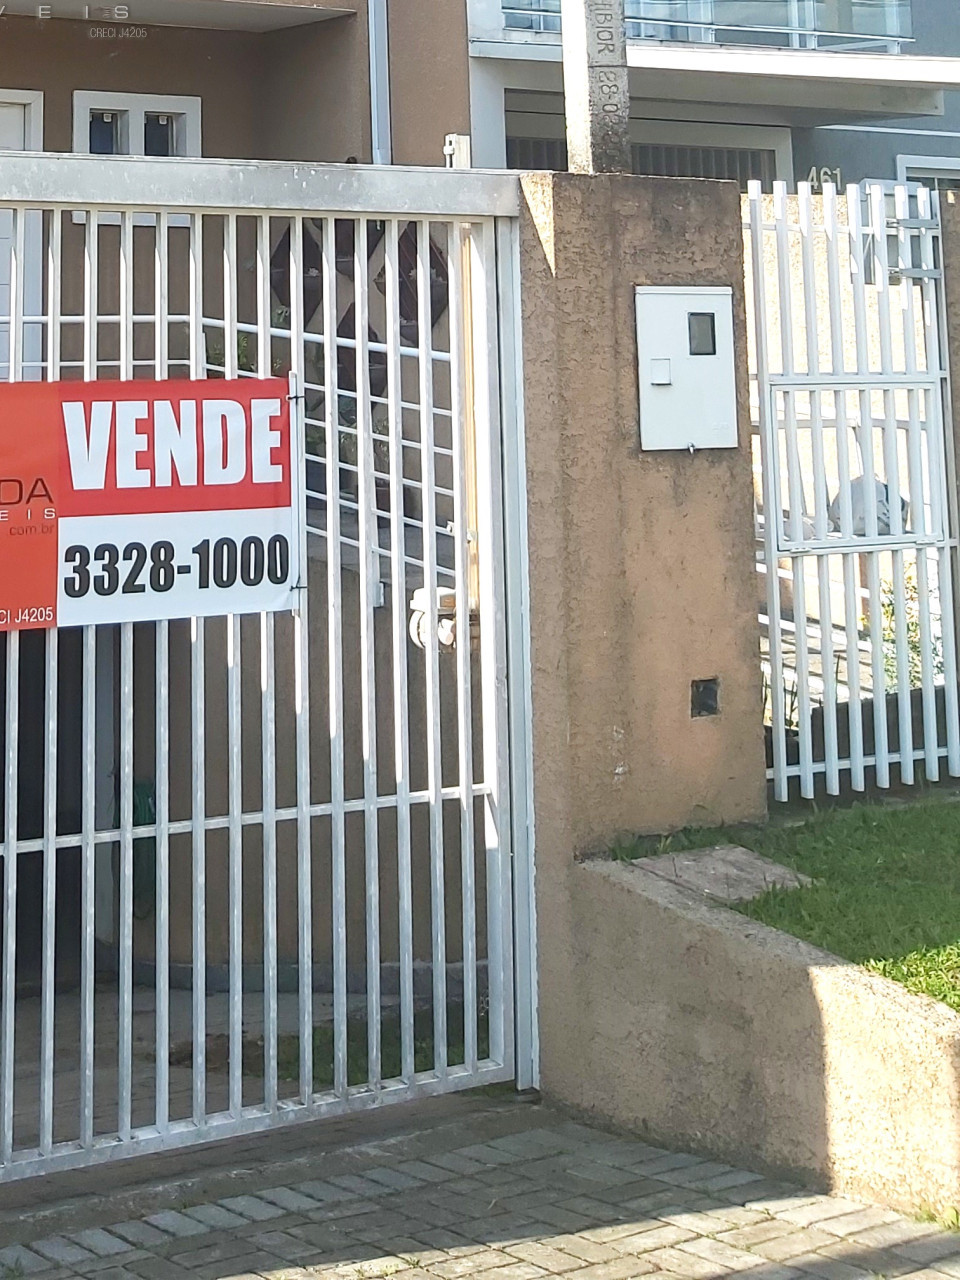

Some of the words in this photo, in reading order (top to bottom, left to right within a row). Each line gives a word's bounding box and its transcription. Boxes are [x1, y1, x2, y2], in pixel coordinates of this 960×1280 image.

[807, 166, 842, 191] 461
[62, 398, 283, 490] VENDE
[63, 533, 290, 598] 3328-1000
[14, 607, 54, 624] J4205
